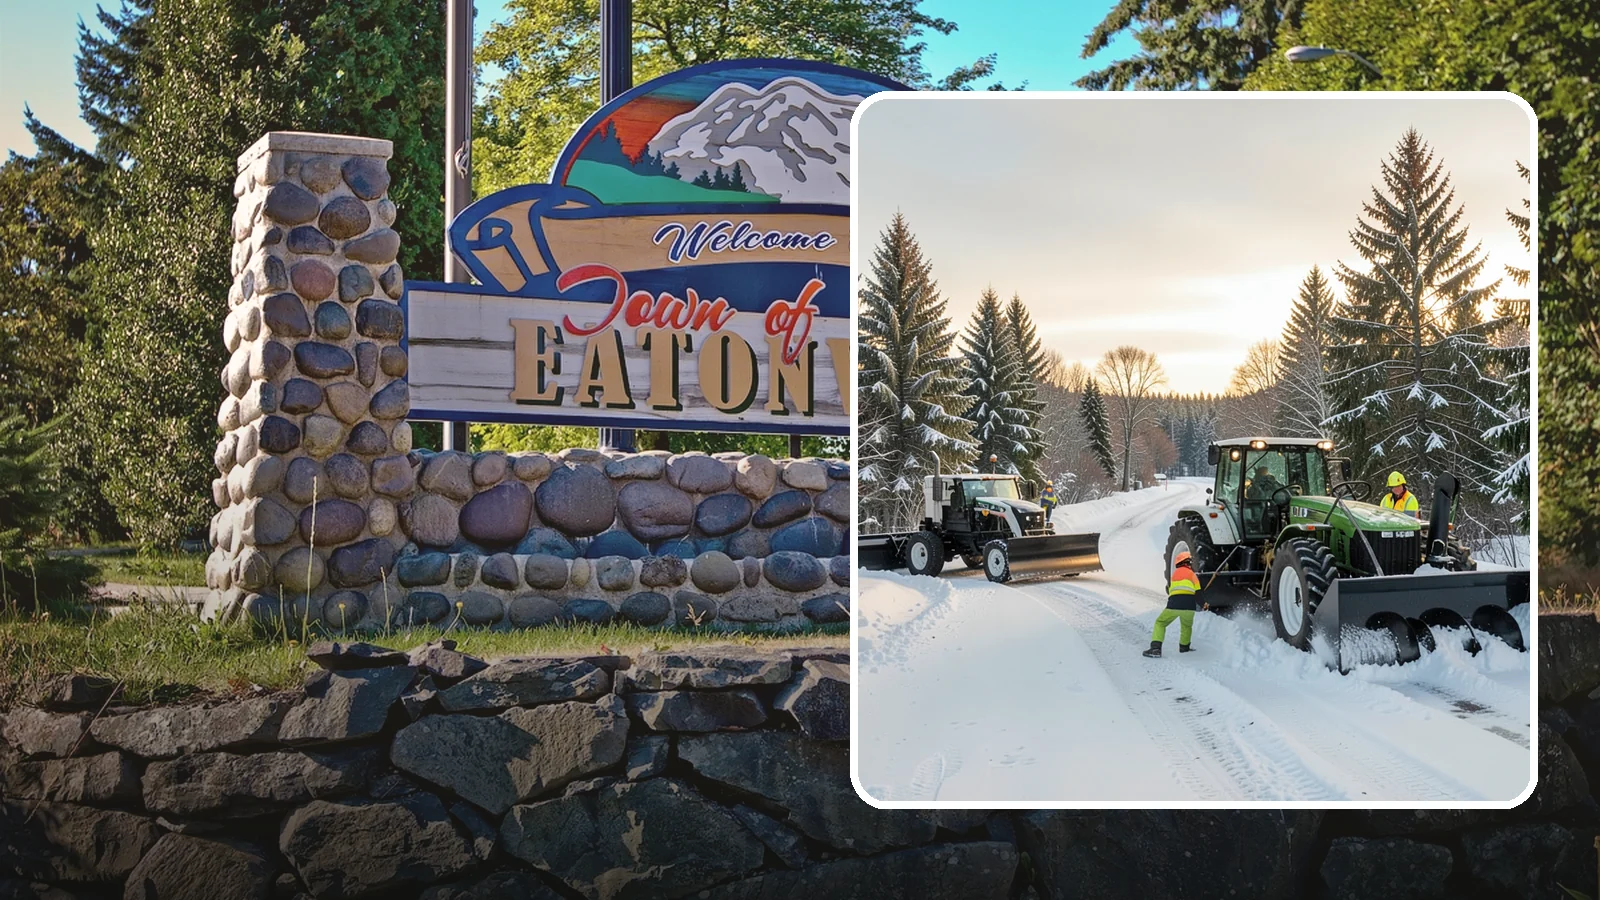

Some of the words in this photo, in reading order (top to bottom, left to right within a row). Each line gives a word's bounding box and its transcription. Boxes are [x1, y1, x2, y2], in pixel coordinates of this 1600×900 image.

[653, 221, 836, 262] Welcome
[557, 264, 737, 336] Town
[764, 278, 826, 364] of
